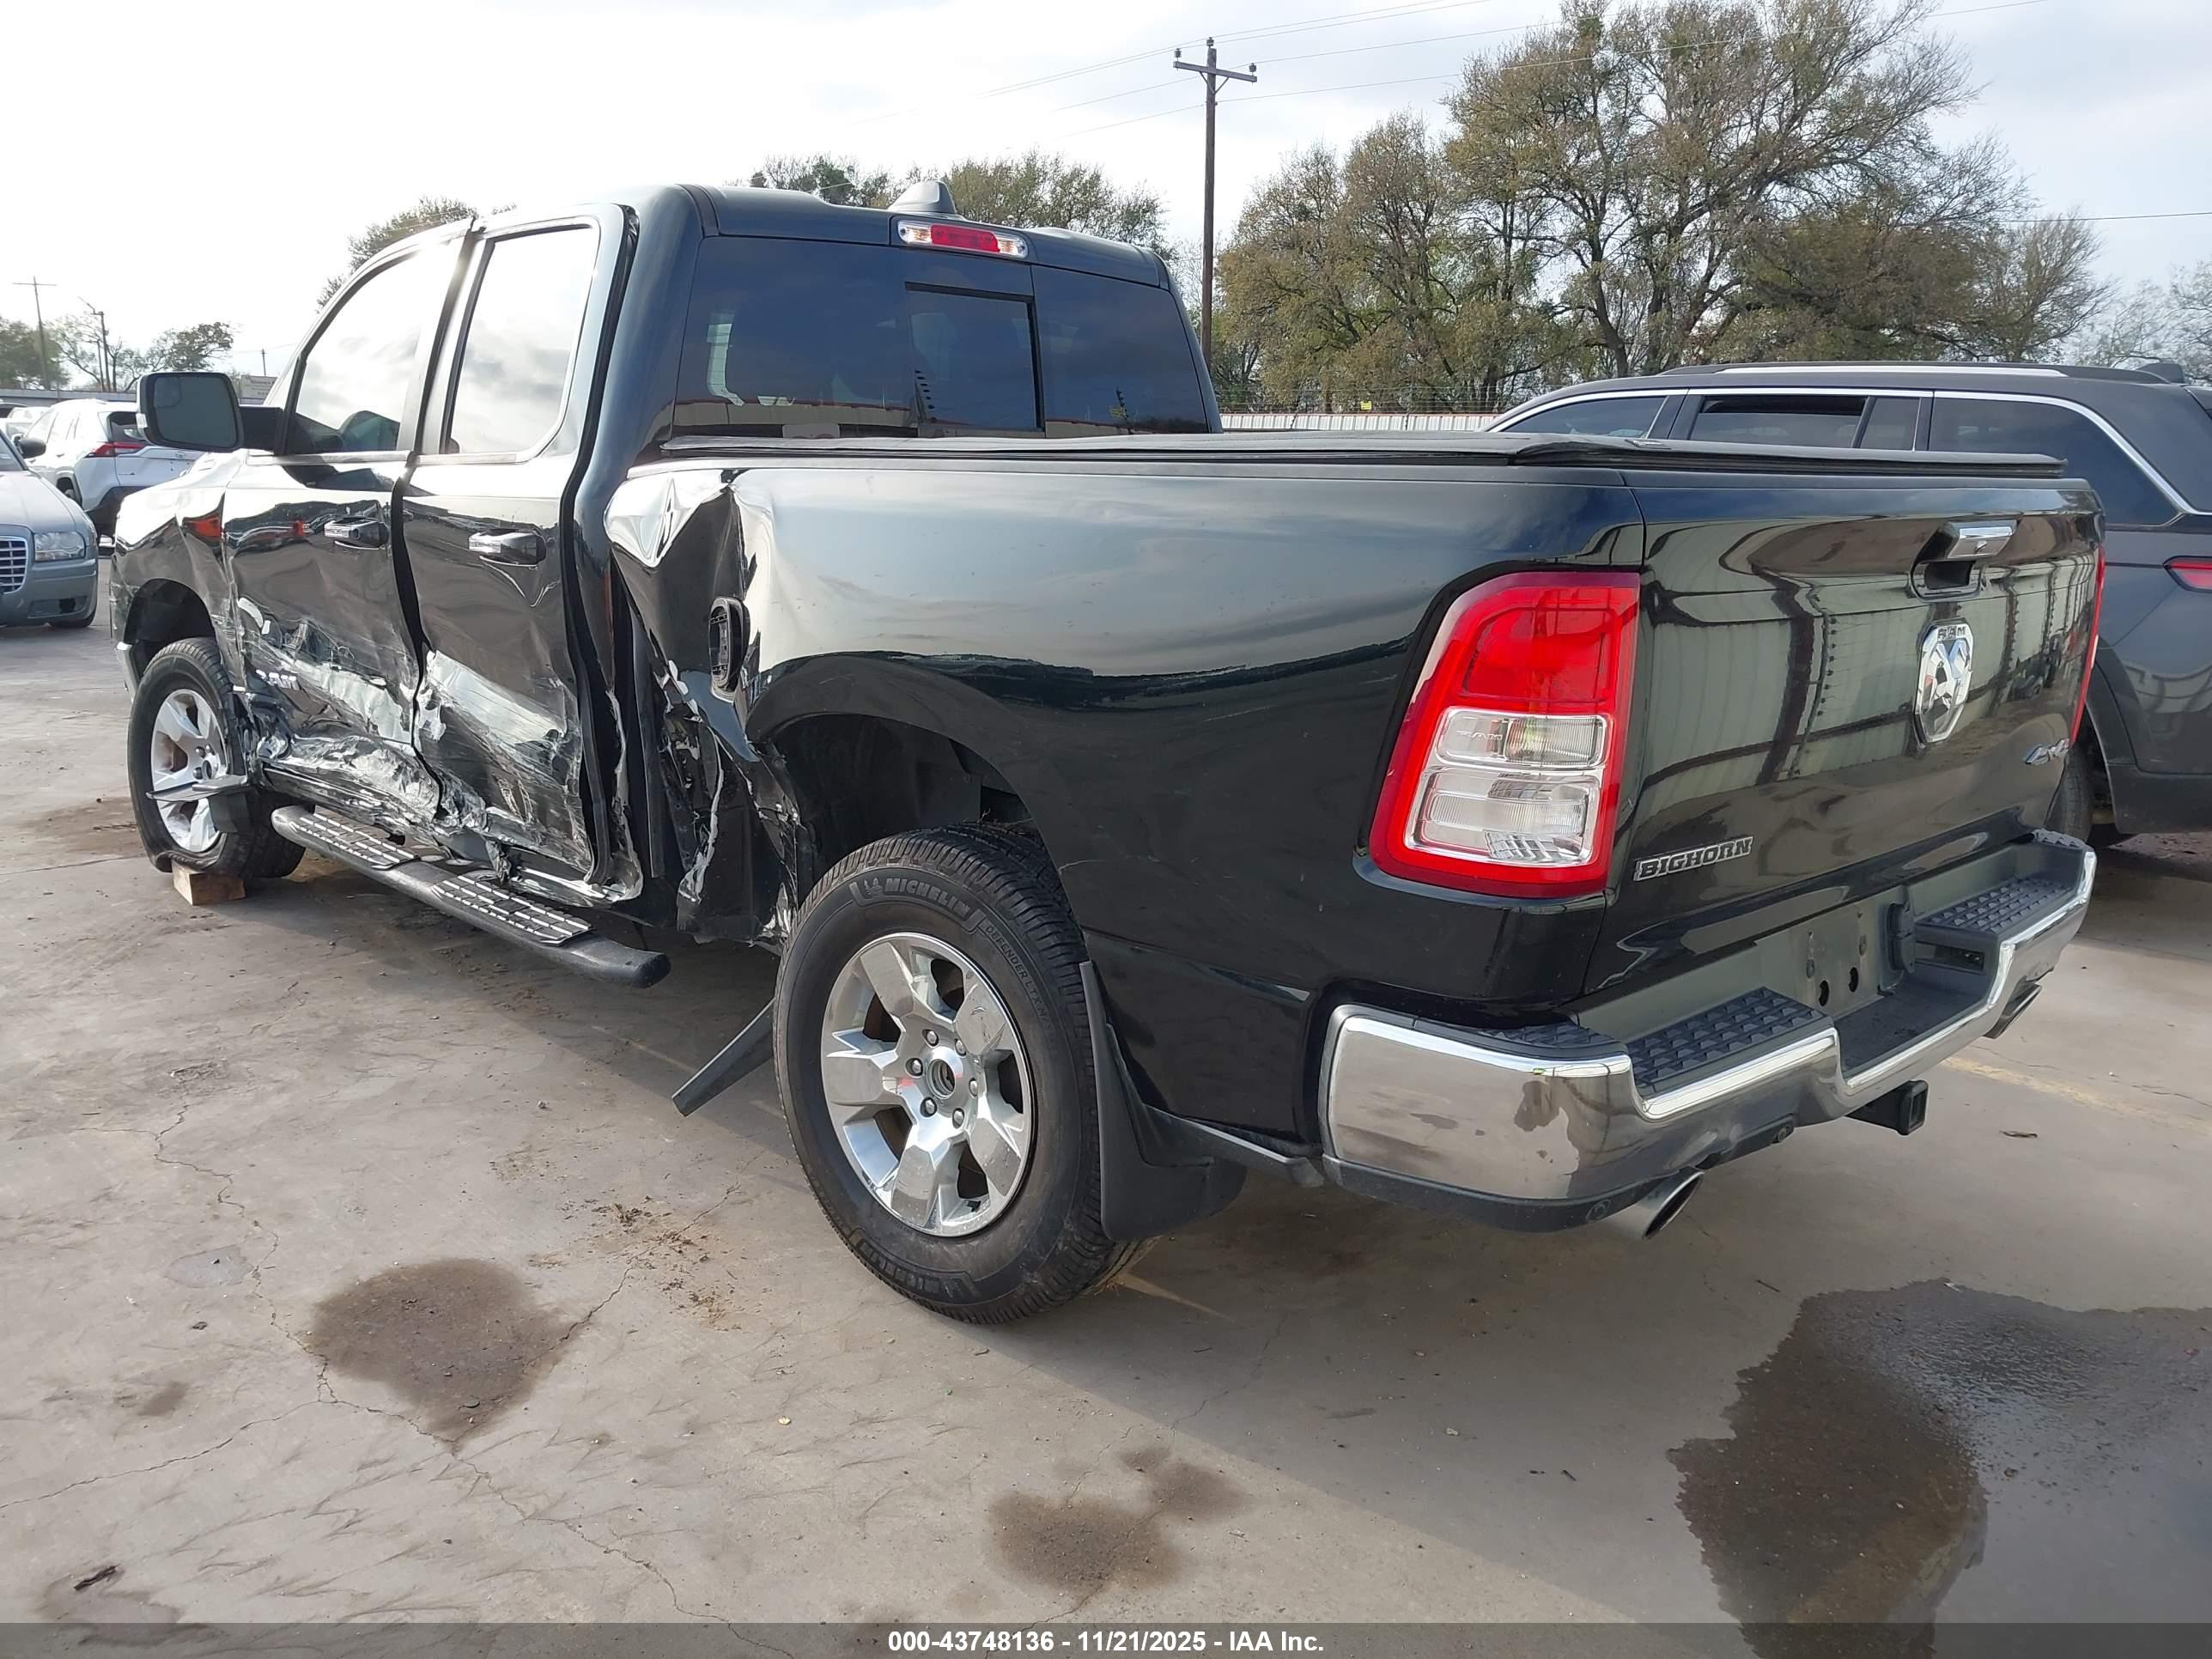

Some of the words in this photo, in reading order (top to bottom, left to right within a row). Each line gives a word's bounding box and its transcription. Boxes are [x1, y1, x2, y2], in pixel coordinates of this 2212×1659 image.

[1937, 627, 1966, 641] RAM
[1633, 836, 1753, 881] BIGHORN
[884, 878, 971, 916] MICHELIN
[985, 926, 1029, 979] DEFENDER
